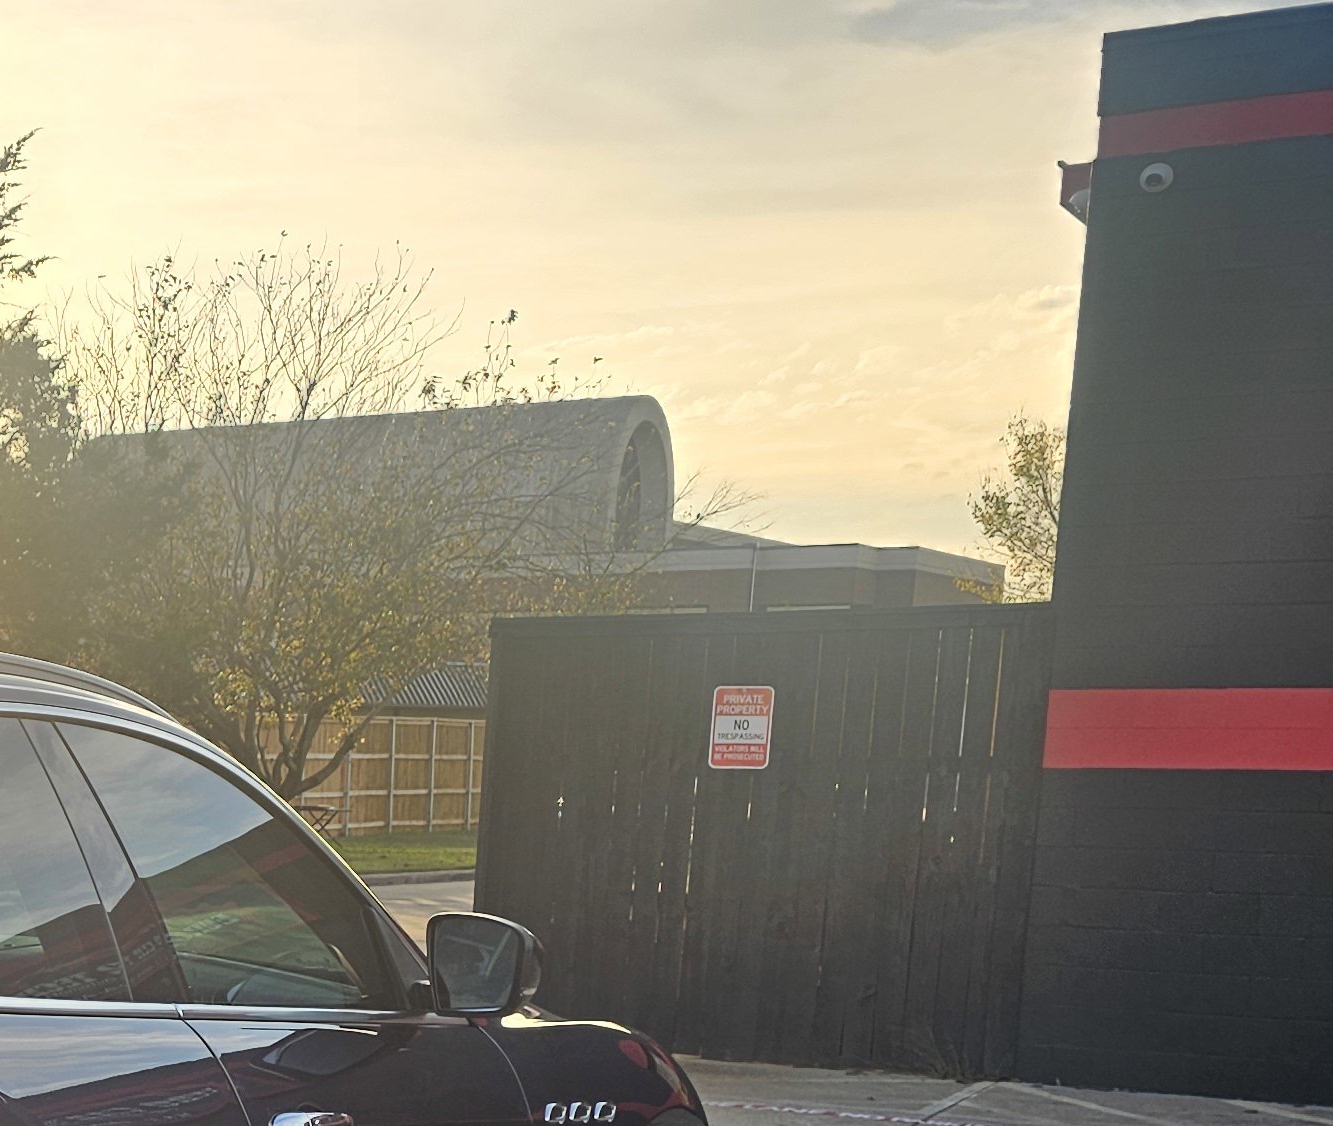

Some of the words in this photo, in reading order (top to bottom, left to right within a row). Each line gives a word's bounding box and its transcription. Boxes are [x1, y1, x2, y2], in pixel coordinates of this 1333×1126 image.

[723, 694, 764, 704] PRIVATE
[716, 704, 770, 714] PROPERTY
[733, 719, 750, 730] NO
[717, 732, 765, 740] TRESPASSING
